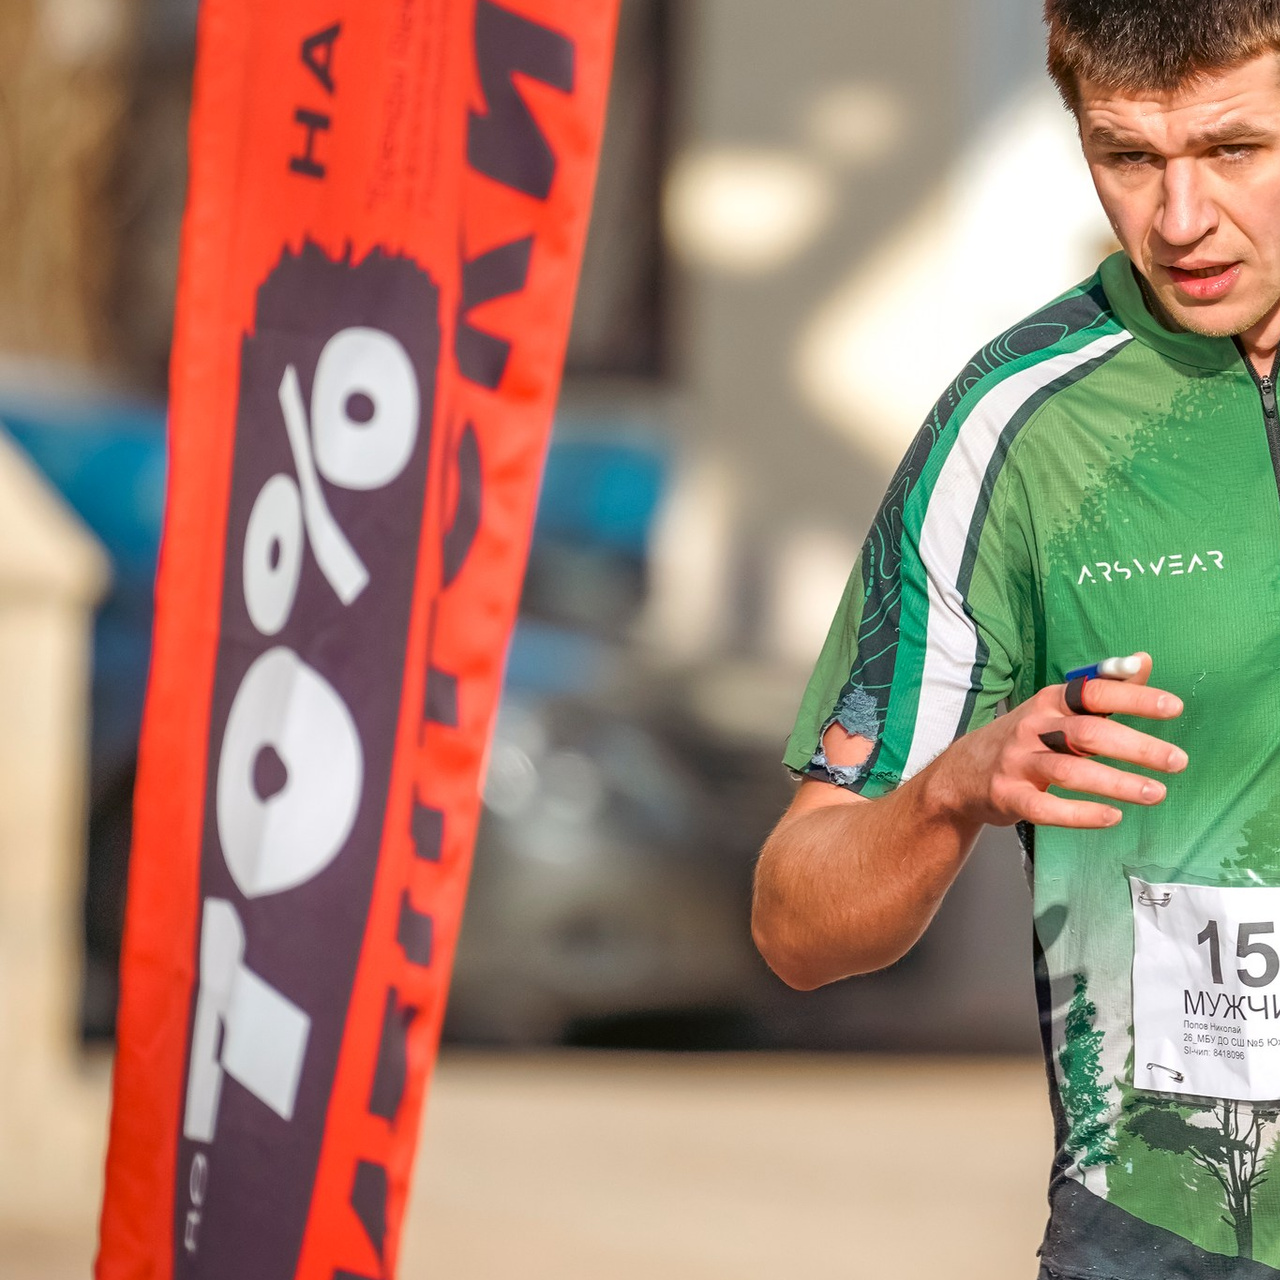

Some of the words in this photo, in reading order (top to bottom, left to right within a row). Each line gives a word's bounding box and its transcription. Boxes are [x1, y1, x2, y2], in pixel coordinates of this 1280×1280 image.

[287, 21, 343, 181] НА
[1077, 550, 1224, 585] ARSWEAR
[183, 326, 421, 1142] 70%
[1183, 1020, 1208, 1031] Попов
[1210, 1022, 1241, 1034] Николай
[1183, 1033, 1216, 1045] 26_МБУ
[1217, 1036, 1229, 1046] ДО
[1231, 1038, 1245, 1048] СШ
[1247, 1038, 1264, 1048] №5
[1184, 1046, 1211, 1057] SI-чип:
[1213, 1048, 1245, 1060] 8418096
